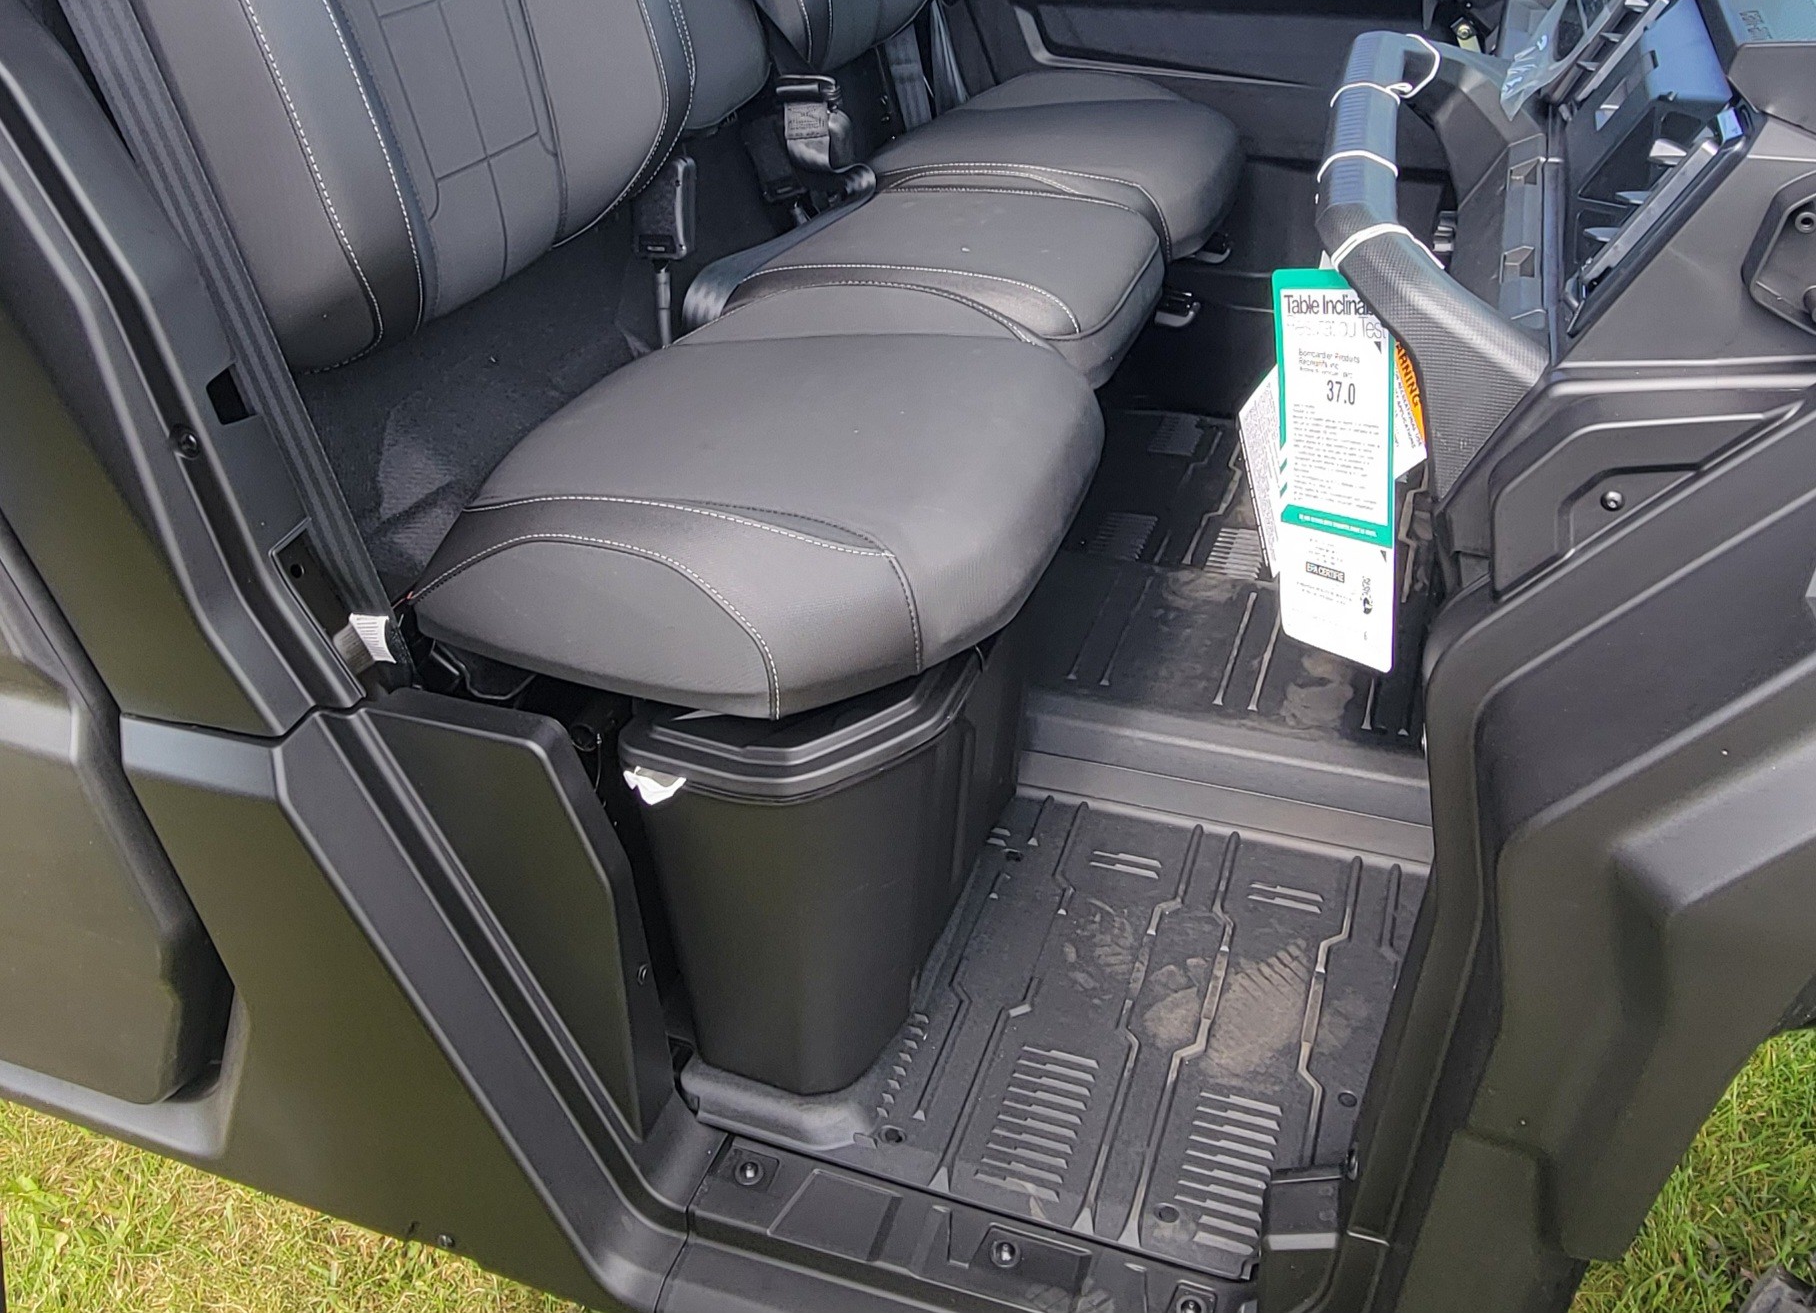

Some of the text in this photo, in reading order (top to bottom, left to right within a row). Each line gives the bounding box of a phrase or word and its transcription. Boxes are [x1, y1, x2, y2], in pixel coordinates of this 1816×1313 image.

[1283, 294, 1320, 314] Table
[1359, 316, 1387, 339] Test
[1396, 342, 1419, 408] ARNING
[1326, 380, 1355, 405] 37.0
